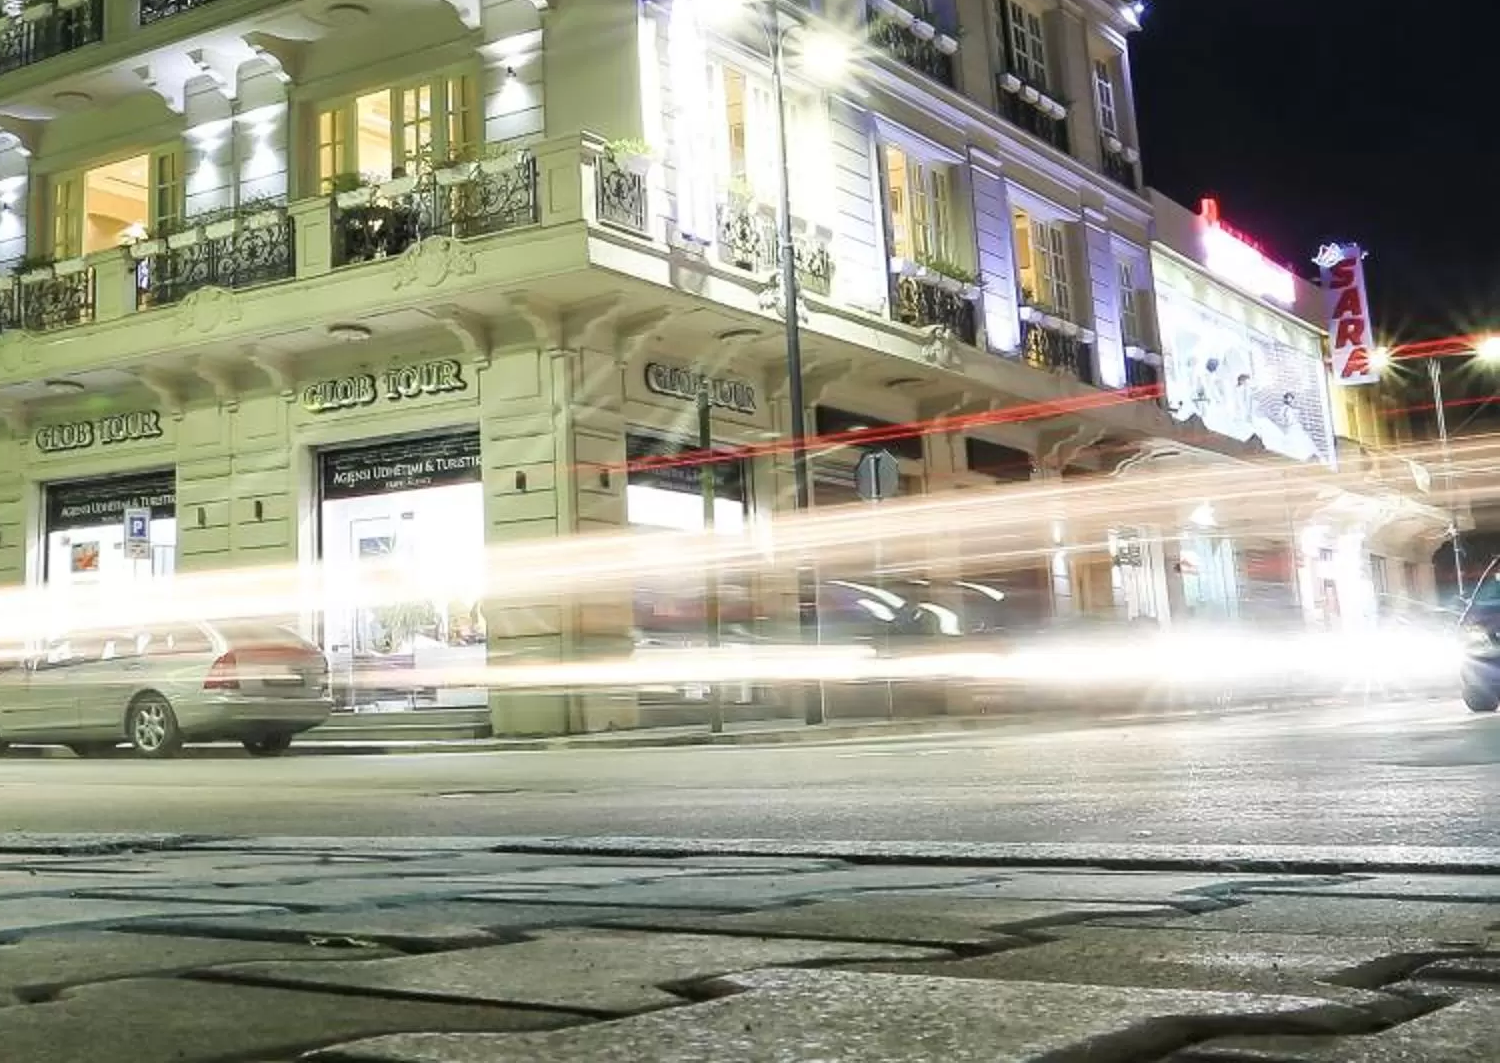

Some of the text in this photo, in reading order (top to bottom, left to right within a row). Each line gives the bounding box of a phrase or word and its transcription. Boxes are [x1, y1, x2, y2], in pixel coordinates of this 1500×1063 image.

[1329, 257, 1370, 378] SARA
[383, 359, 467, 399] TOUR
[36, 409, 163, 453] GLOB TOUR
